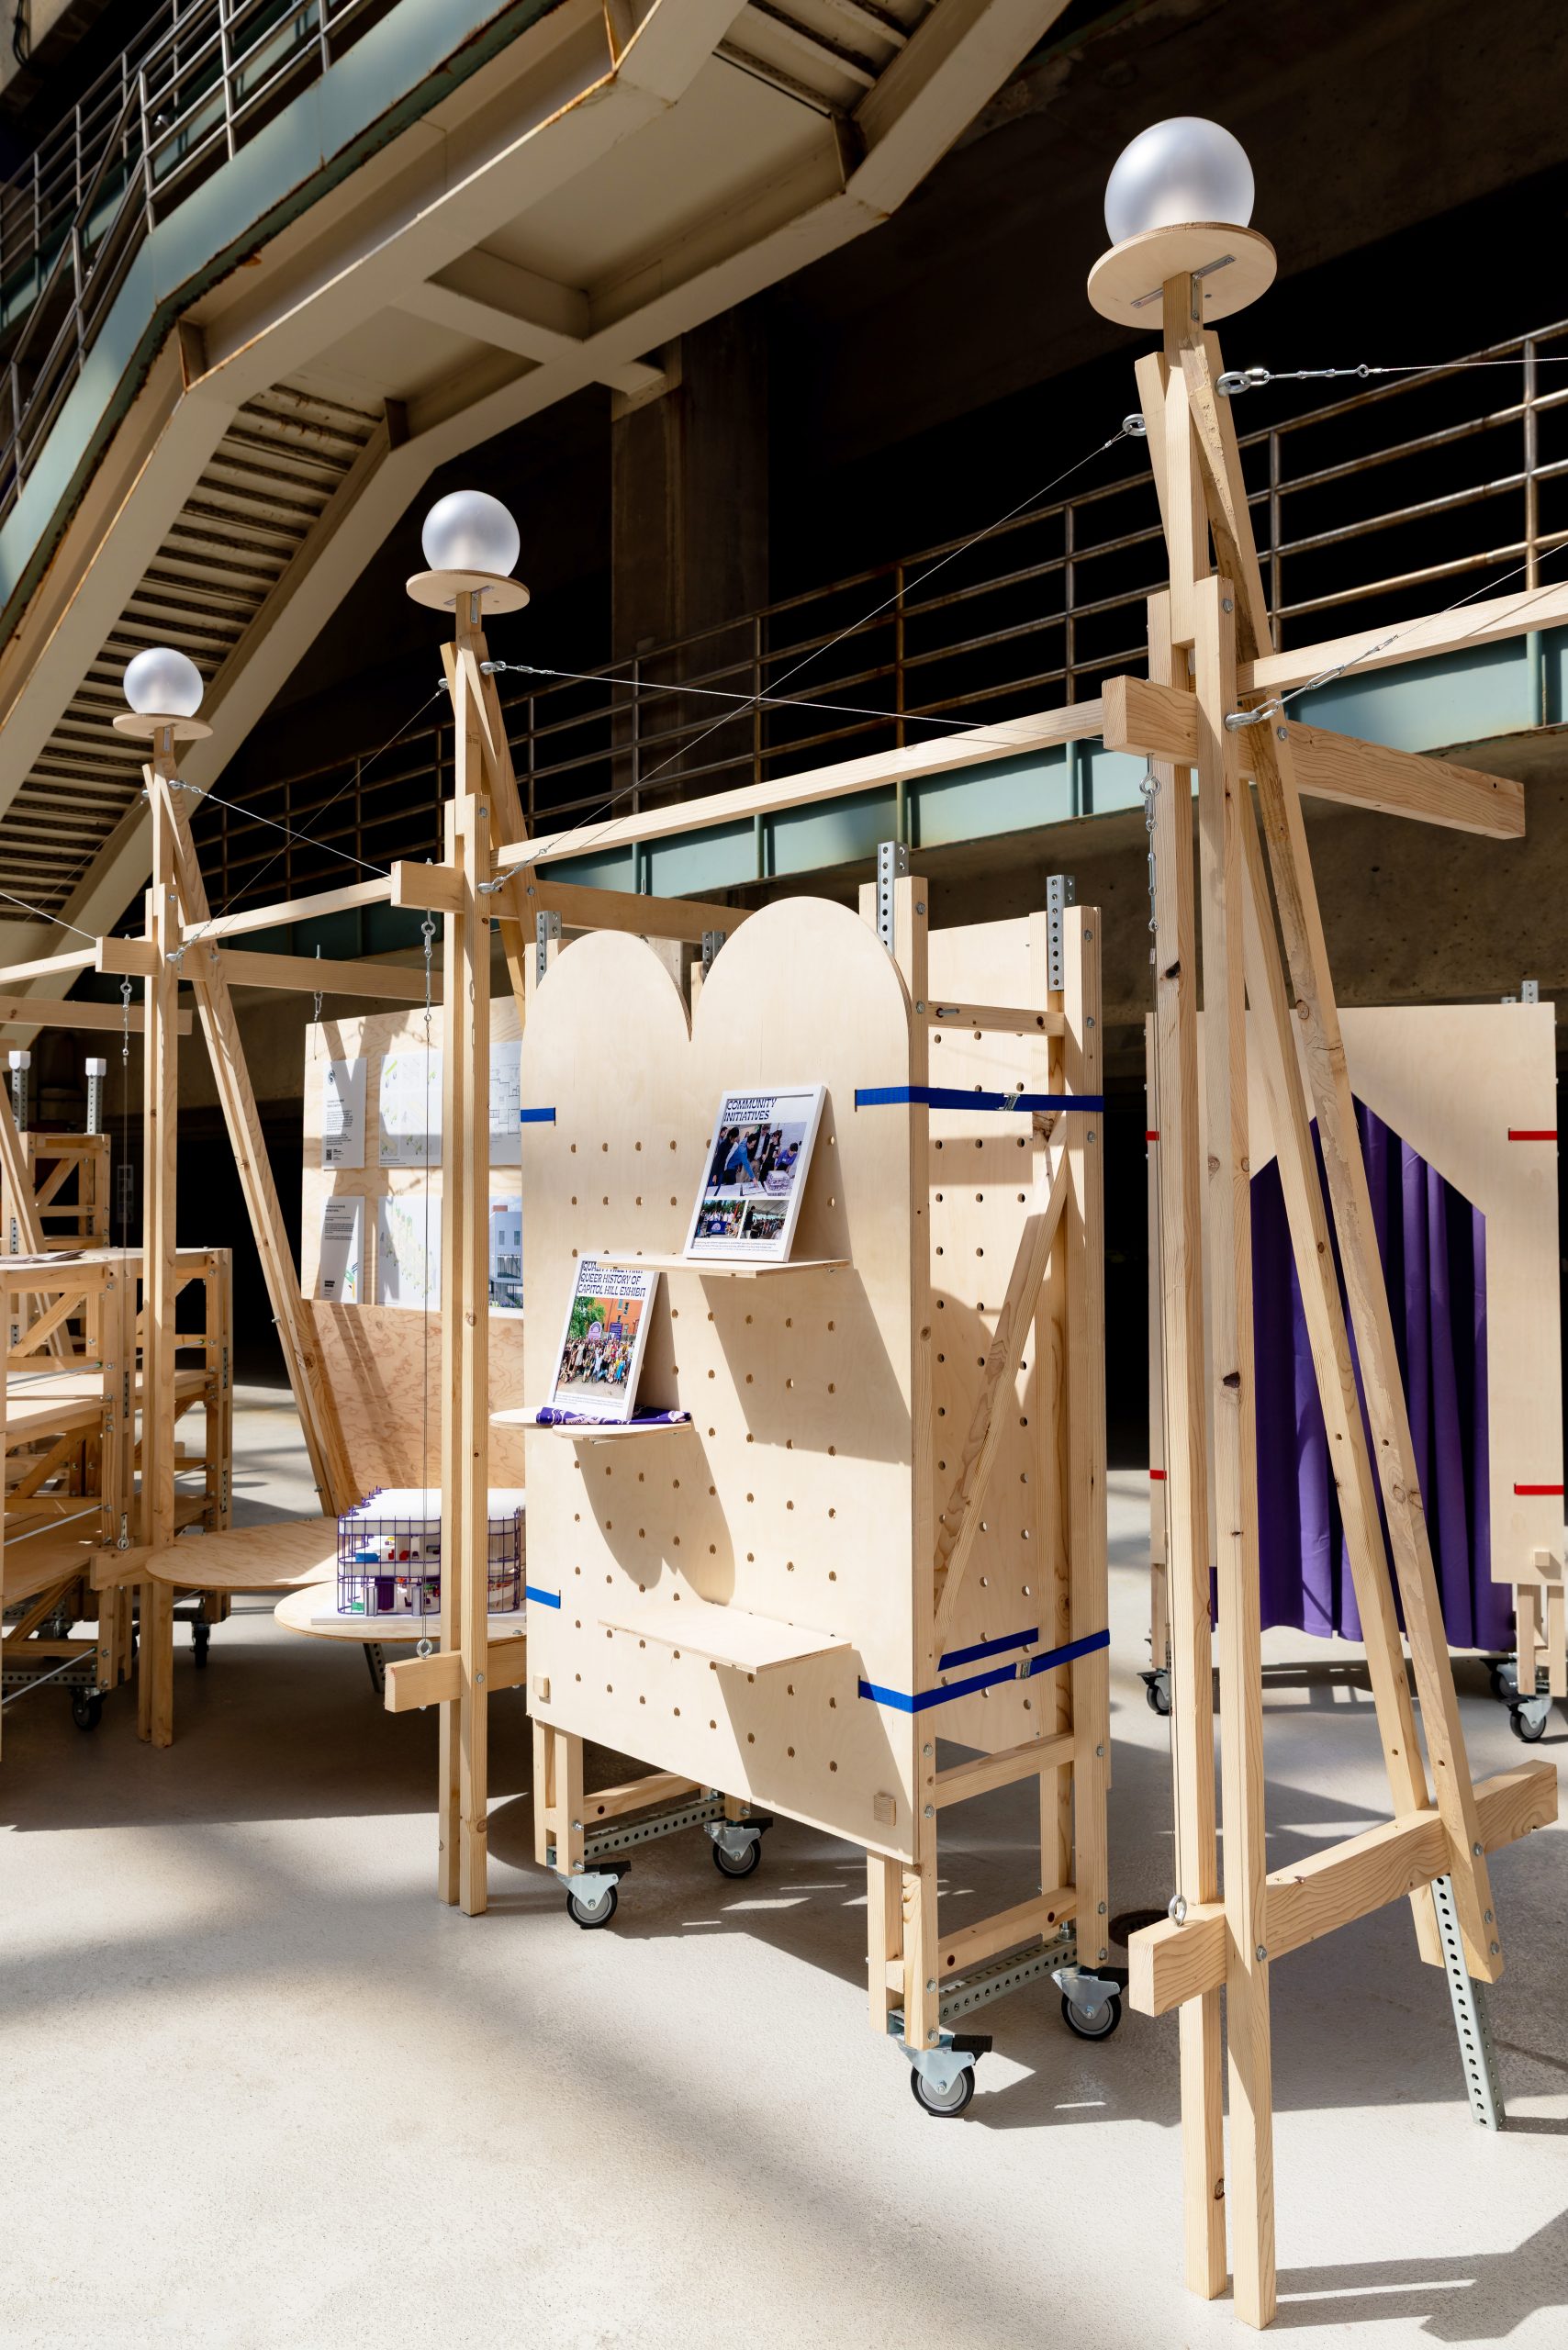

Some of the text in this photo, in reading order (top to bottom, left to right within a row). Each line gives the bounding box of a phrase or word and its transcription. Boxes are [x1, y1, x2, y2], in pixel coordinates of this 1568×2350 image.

[727, 1098, 777, 1110] COMMUNITY
[723, 1111, 769, 1122] INITIATIVES
[580, 1272, 641, 1285] QUEER HISTORY OF
[578, 1284, 645, 1297] CAPITOL HILL EXHIBIT
